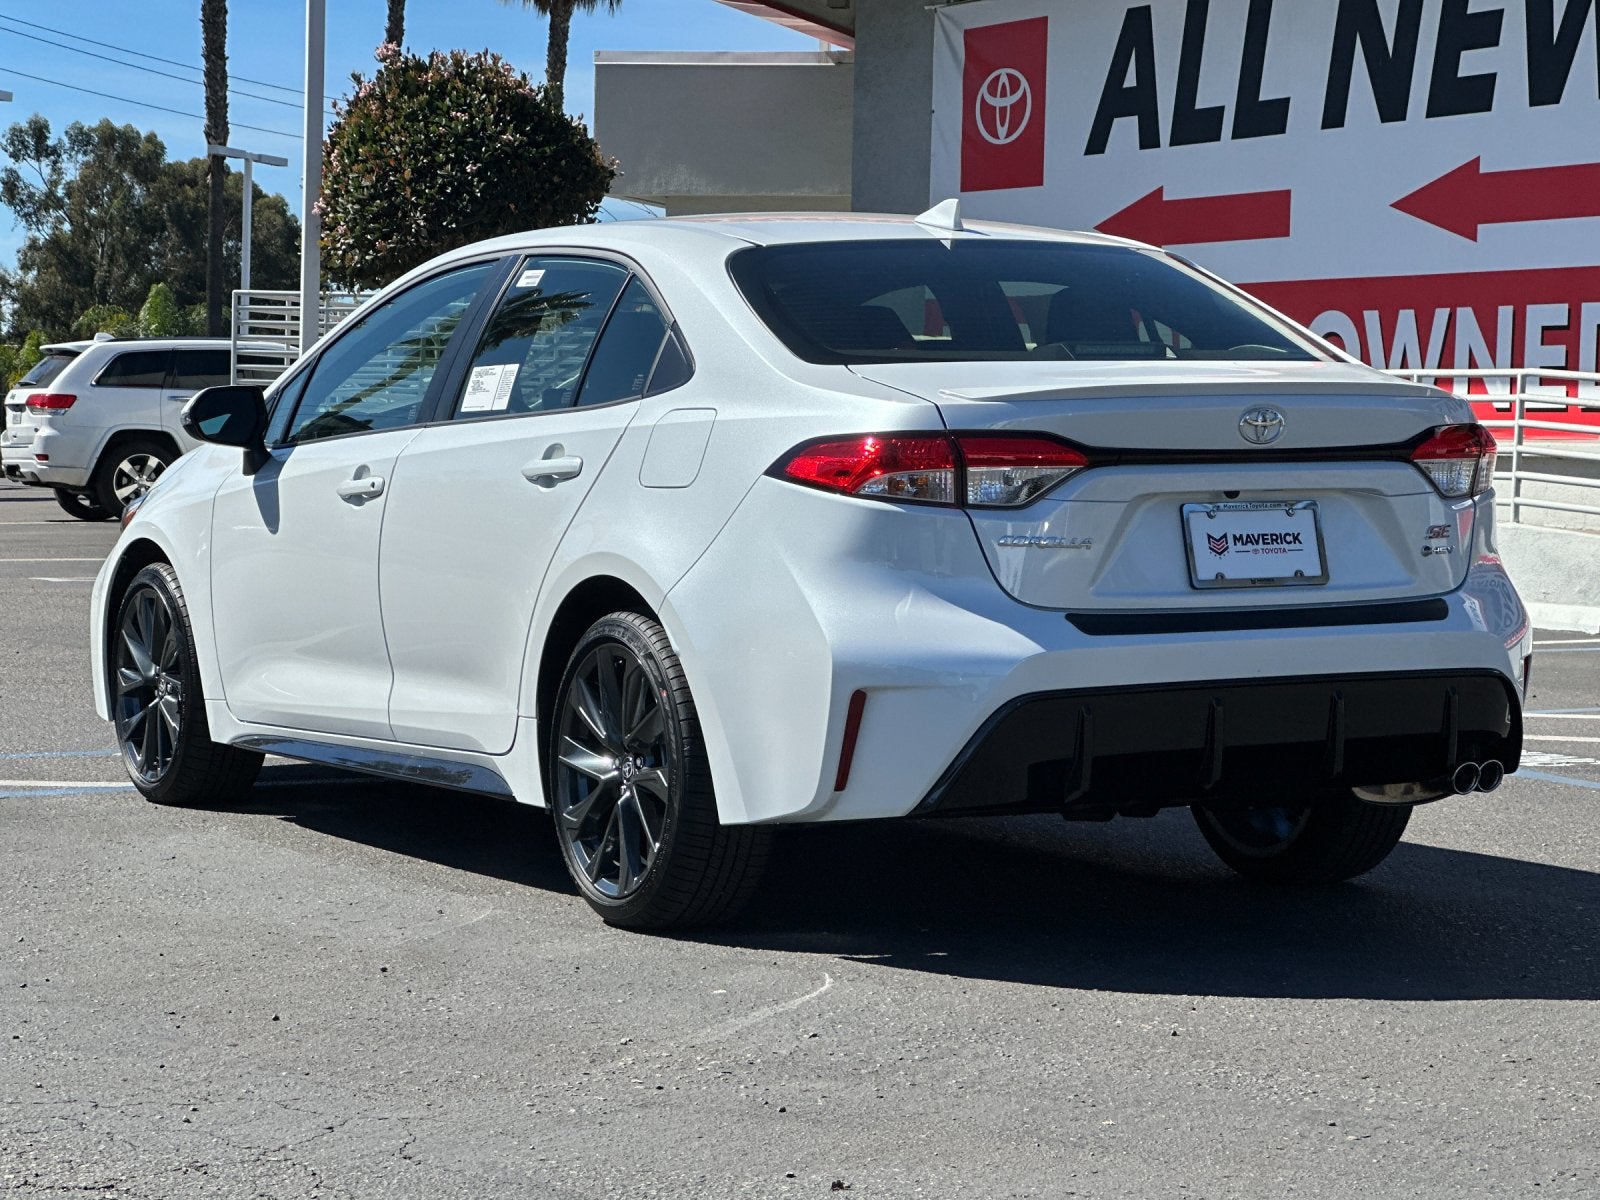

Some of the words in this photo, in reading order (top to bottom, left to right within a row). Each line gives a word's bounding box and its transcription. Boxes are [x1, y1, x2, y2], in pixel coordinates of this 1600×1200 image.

[1084, 0, 1291, 156] ALL
[1308, 302, 1600, 409] WNE
[1223, 501, 1282, 510] MaverickToyota.com
[1425, 524, 1451, 539] SE
[1232, 532, 1302, 546] MAVERICK
[1260, 547, 1288, 555] TOYOTA
